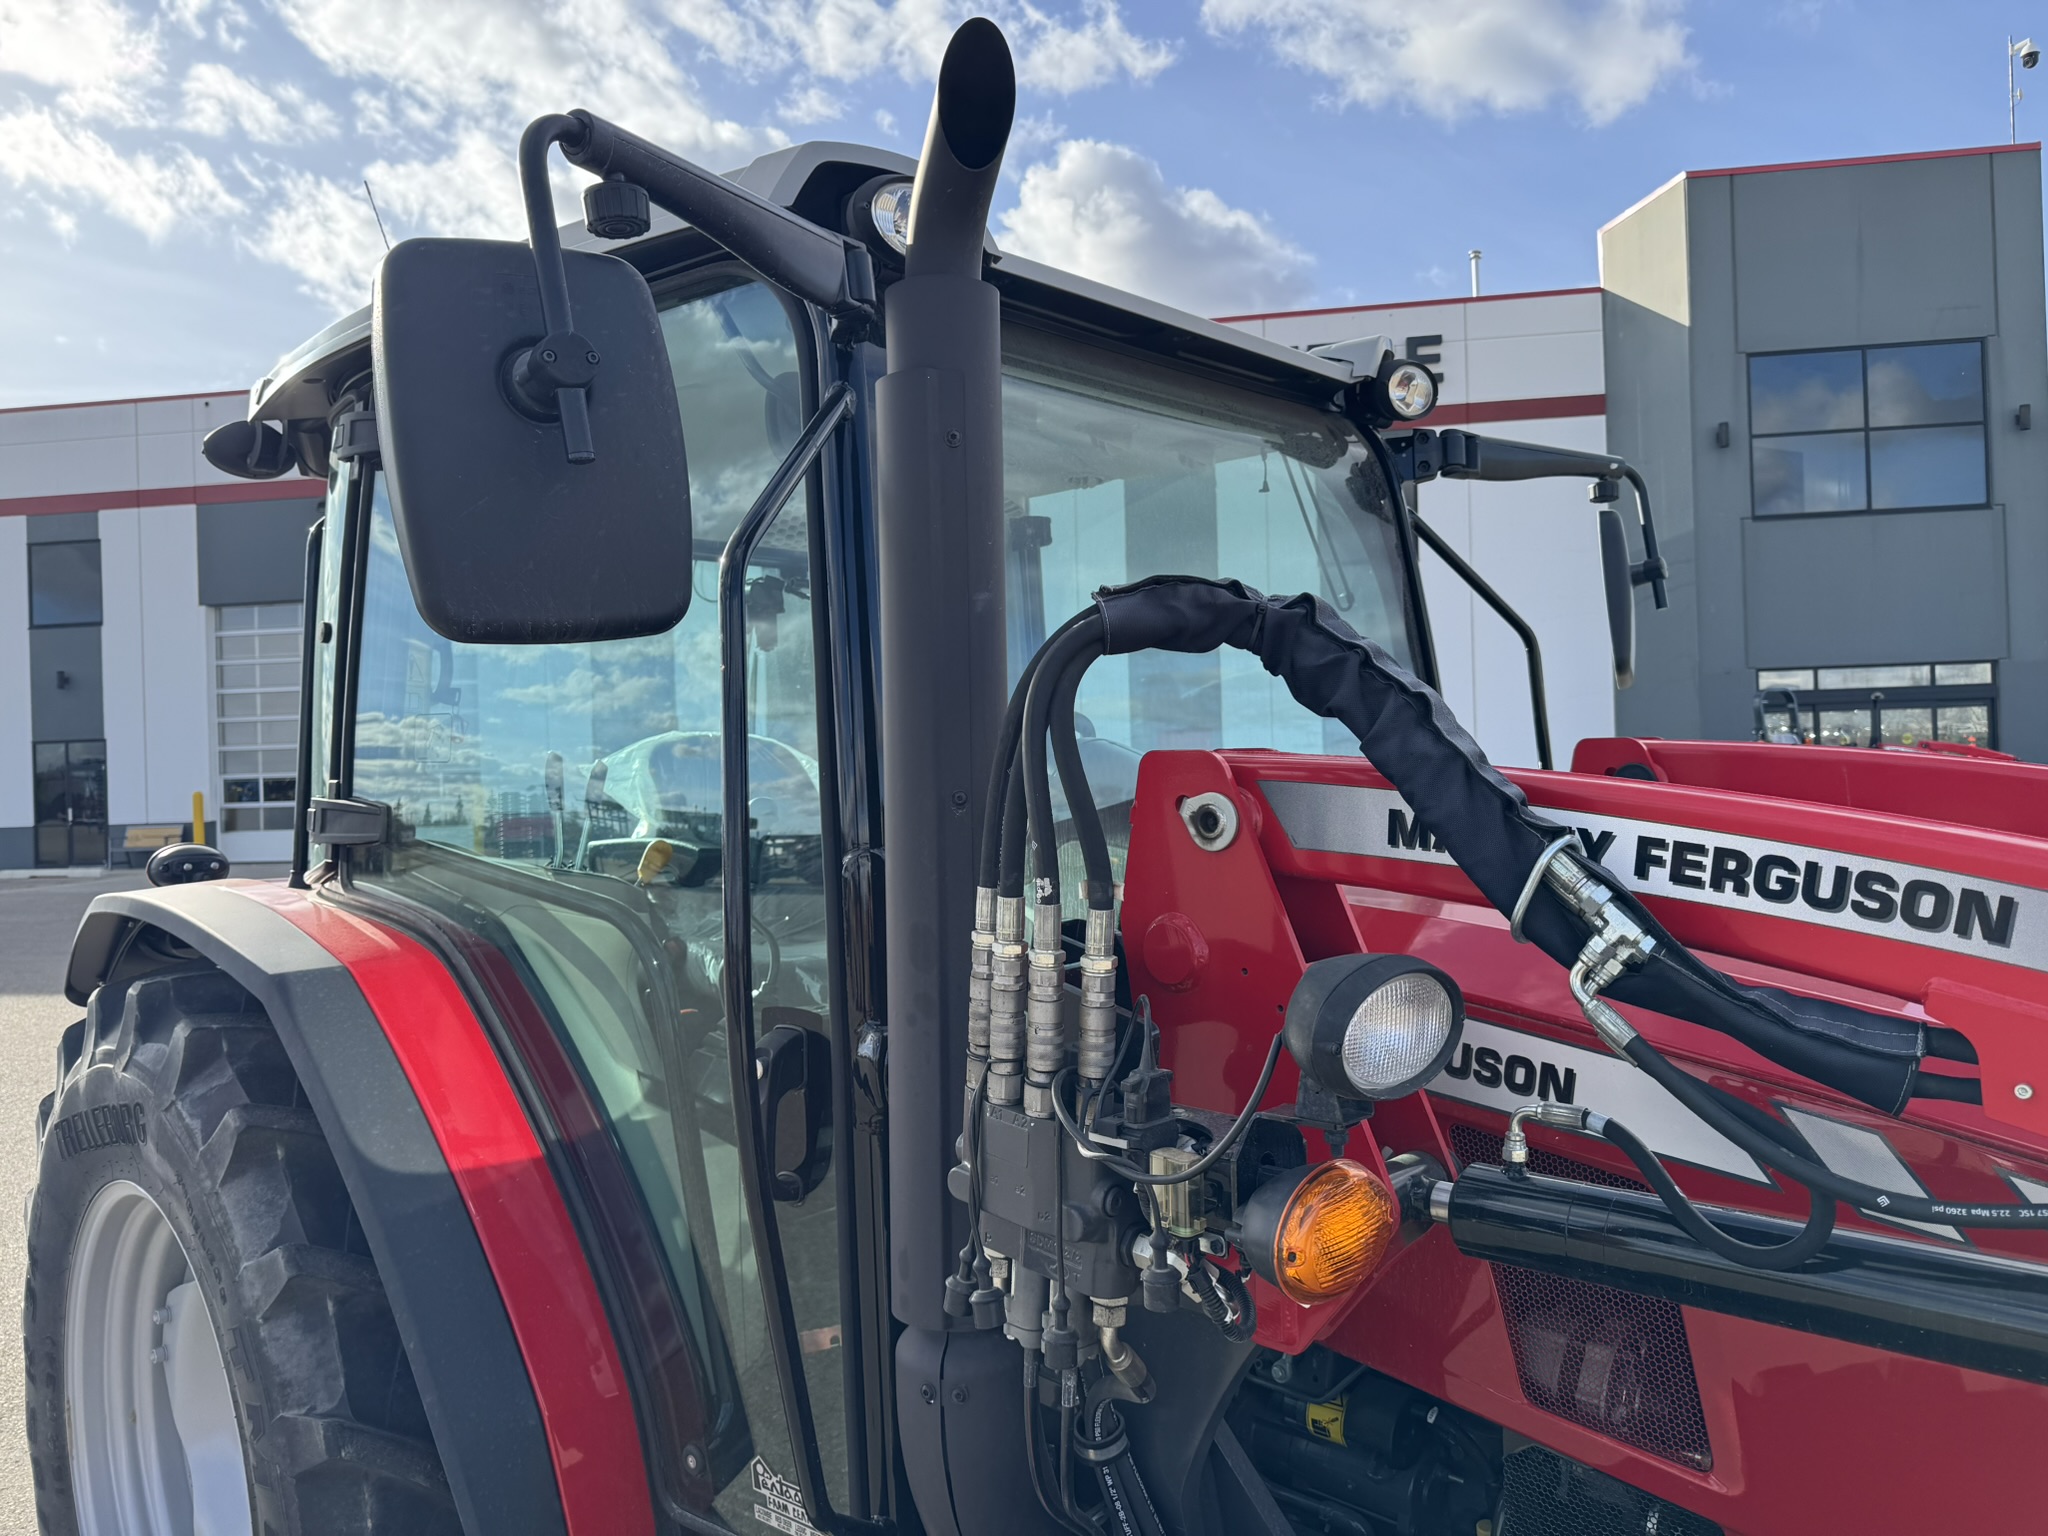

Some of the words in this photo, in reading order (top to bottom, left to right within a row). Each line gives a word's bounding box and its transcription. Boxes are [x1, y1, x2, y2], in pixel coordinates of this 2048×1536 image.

[1633, 834, 2019, 949] FERGUSON
[1444, 1042, 1577, 1104] USON
[54, 1102, 148, 1161] TRELLEBORG
[1931, 1205, 1944, 1213] psi
[1945, 1206, 1967, 1216] 3260
[1991, 1209, 2011, 1218] 22.5
[768, 1496, 791, 1515] FARM
